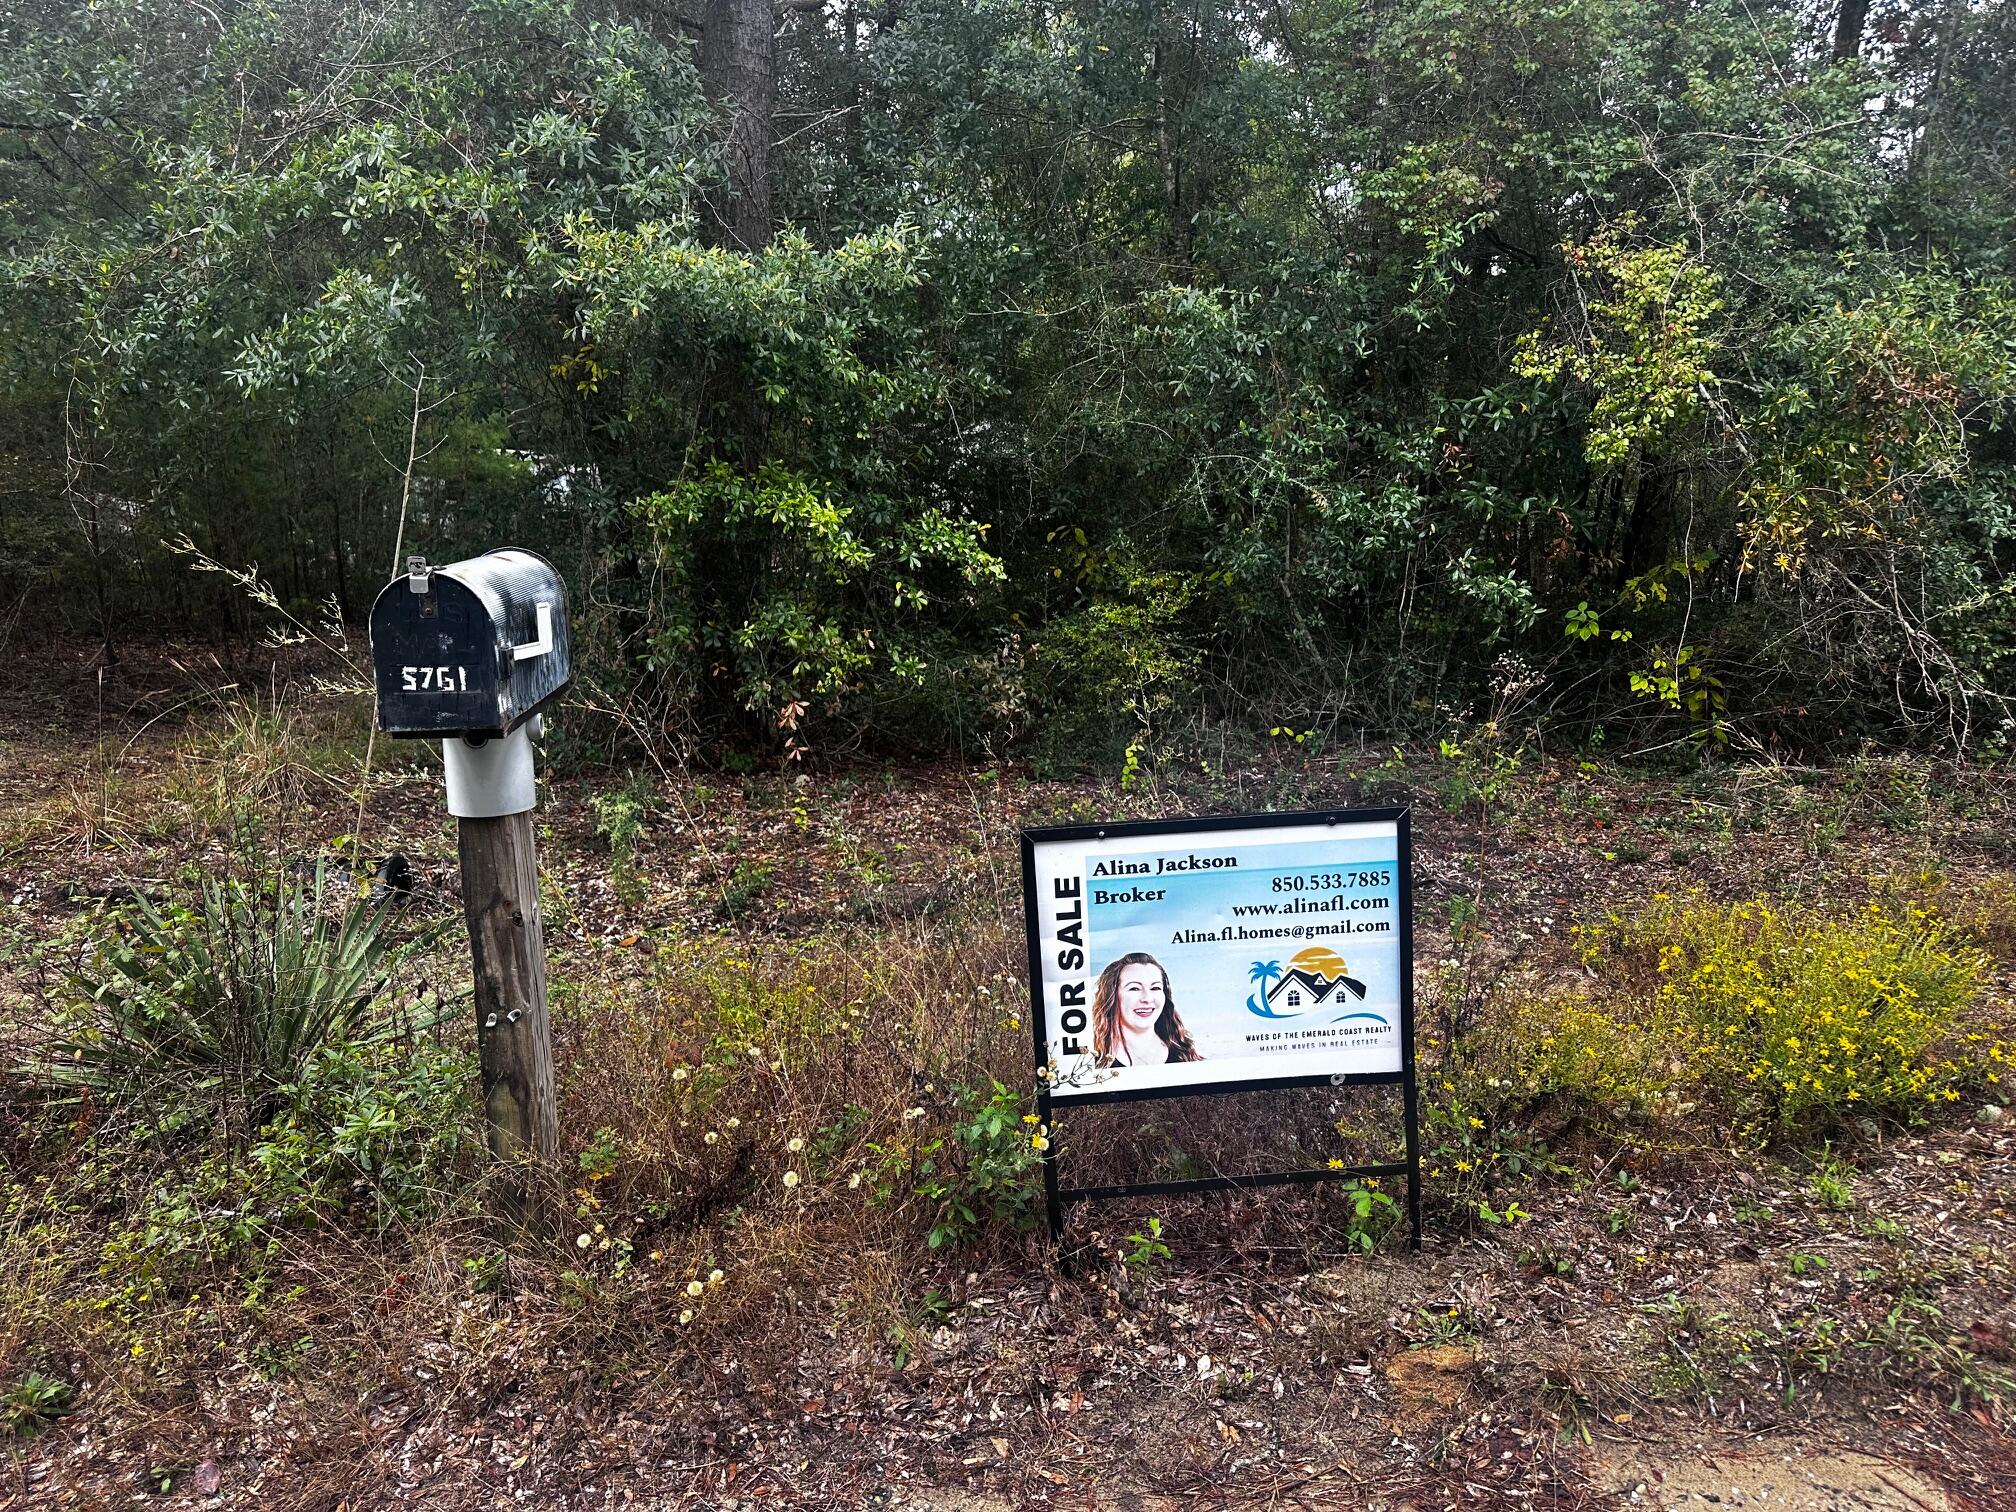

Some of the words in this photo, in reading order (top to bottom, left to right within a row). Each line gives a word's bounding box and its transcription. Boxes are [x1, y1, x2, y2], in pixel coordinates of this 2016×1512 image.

[1092, 860, 1150, 877] Alina
[1156, 854, 1238, 876] Jackson
[1271, 870, 1391, 893] 850.533.7885
[1094, 887, 1167, 905] Broker
[1232, 895, 1390, 917] www.alinafl.com
[1054, 876, 1085, 971] SALE
[1171, 919, 1391, 944] Alina.fl.homes@gmail.com
[1060, 981, 1087, 1056] FOR
[1245, 1033, 1270, 1042] WAVES
[1272, 1032, 1281, 1040] OF
[1284, 1031, 1299, 1039] THE
[1301, 1029, 1336, 1038] EMERALD
[1339, 1027, 1362, 1036] COAST
[1365, 1025, 1392, 1034] REALTY
[1259, 1044, 1288, 1052] MAKING
[1291, 1042, 1315, 1050] WAVES
[1351, 1038, 1379, 1046] ESTATE
